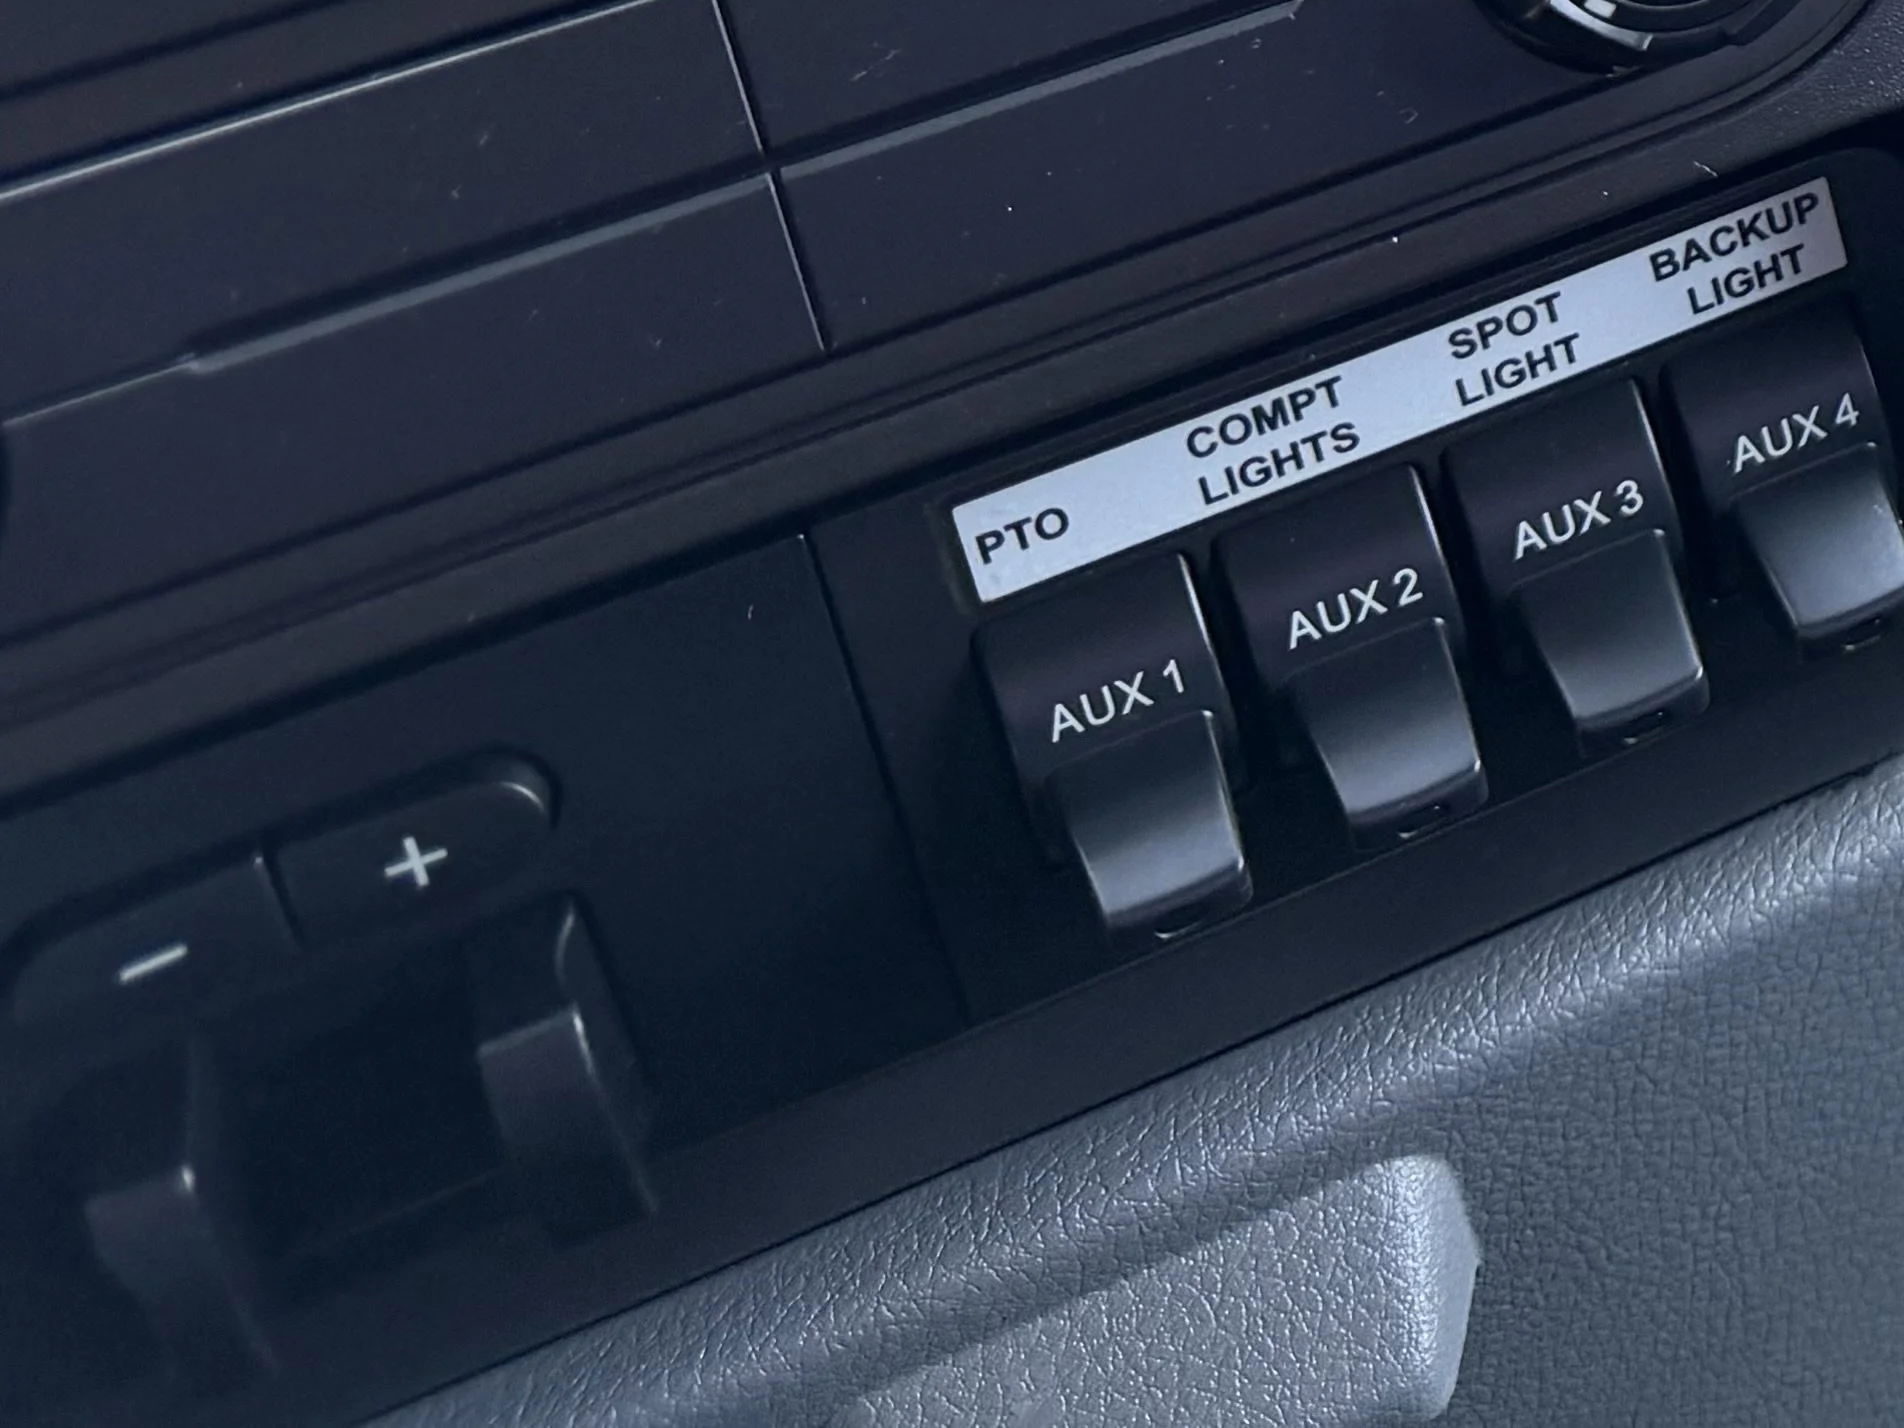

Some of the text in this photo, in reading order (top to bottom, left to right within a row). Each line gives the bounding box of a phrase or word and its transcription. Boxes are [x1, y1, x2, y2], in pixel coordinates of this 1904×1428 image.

[1648, 190, 1821, 284] BACKUP
[1685, 243, 1808, 317] LIGHT
[1446, 291, 1563, 362] SPOT
[1455, 332, 1583, 408] LIGHT
[1185, 375, 1344, 461] COMPT
[1730, 391, 1861, 474] AUX 4
[1196, 420, 1362, 507] LIGHTS
[974, 505, 1070, 566] PTO
[1511, 477, 1646, 561] AUX 3
[1286, 566, 1424, 651] AUX 2
[1049, 656, 1188, 743] AUX 1
